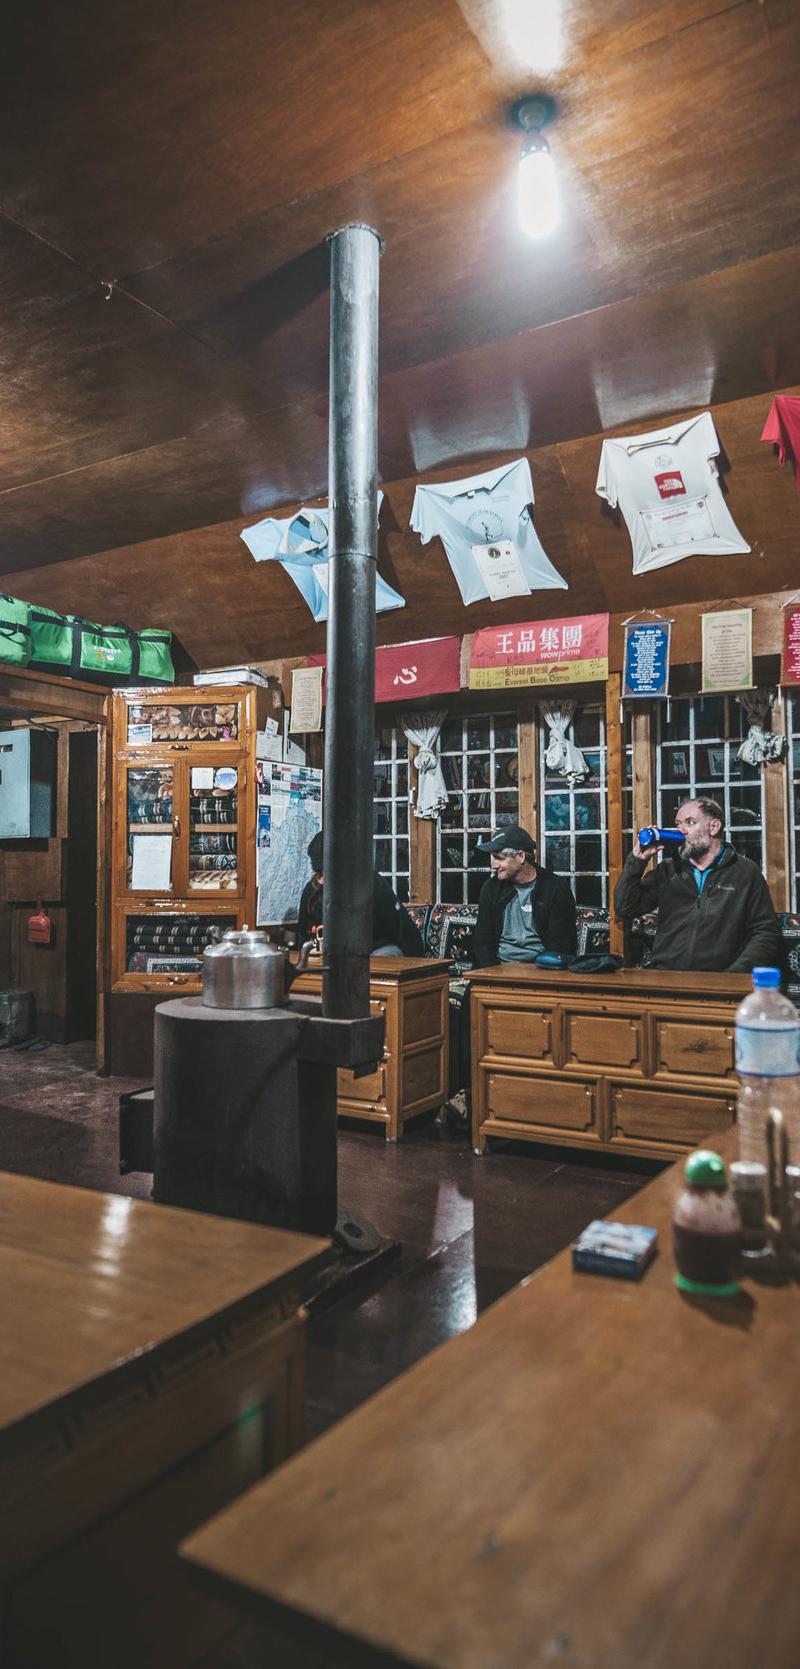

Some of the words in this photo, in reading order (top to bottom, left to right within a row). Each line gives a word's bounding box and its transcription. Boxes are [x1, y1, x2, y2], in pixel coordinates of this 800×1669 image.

[496, 625, 582, 654] 王品集團
[505, 678, 528, 687] Everest
[530, 676, 547, 685] Base
